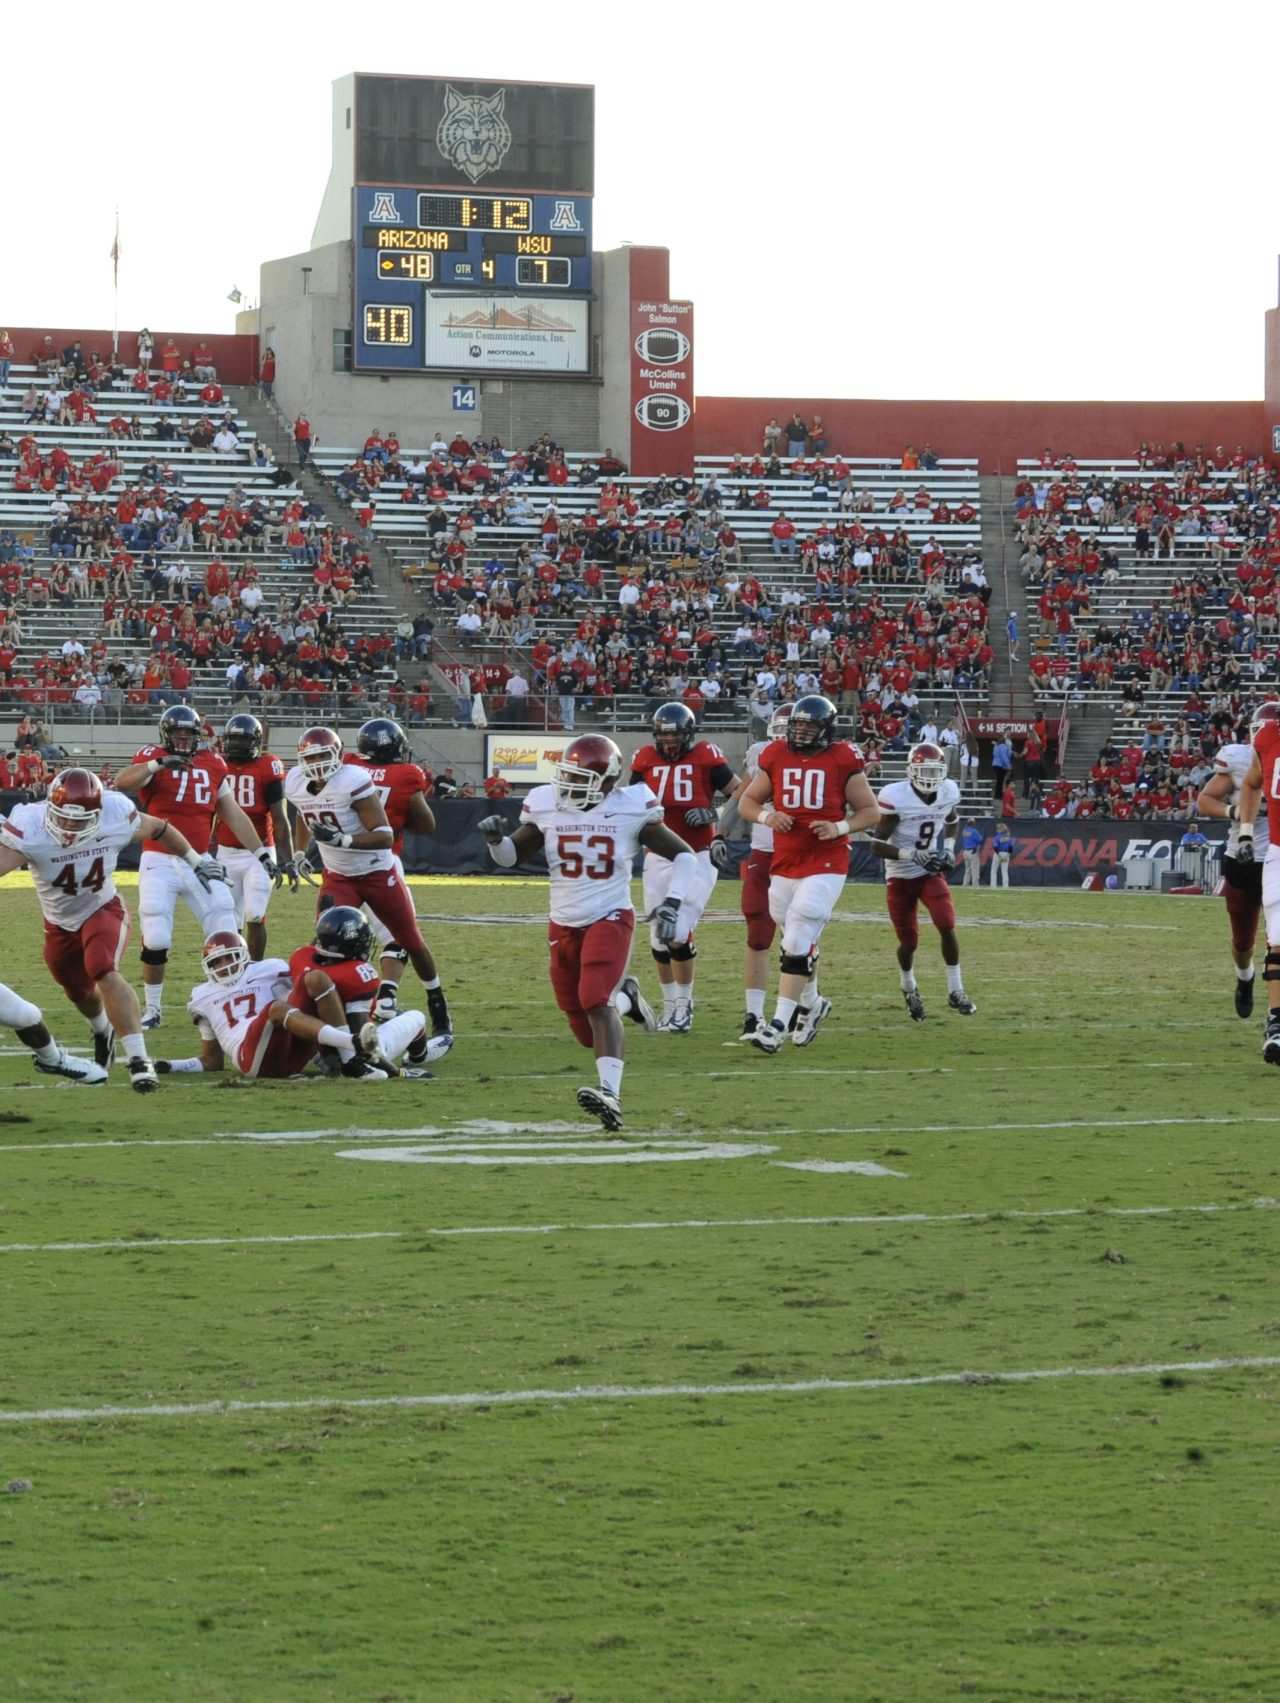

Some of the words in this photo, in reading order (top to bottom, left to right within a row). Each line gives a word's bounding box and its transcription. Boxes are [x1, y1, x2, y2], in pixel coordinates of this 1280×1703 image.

[461, 198, 528, 229] 1:12
[378, 229, 448, 250] ARIZONA
[517, 236, 552, 254] WSU
[401, 254, 431, 278] 48
[481, 260, 494, 279] 4
[534, 260, 548, 283] 7
[638, 303, 657, 312] John
[366, 308, 409, 343] 40
[648, 313, 677, 324] Salmon
[446, 328, 474, 340] Action
[550, 332, 566, 343] Inc.
[640, 368, 686, 379] McCollins
[649, 380, 677, 390] Umeh
[452, 389, 475, 408] 14
[656, 408, 670, 418] 90
[985, 722, 994, 732] 14
[493, 747, 519, 755] 1290
[171, 768, 211, 805] 72
[652, 764, 693, 802] 76
[782, 767, 825, 810] 50
[555, 824, 595, 833] WASHINGTON
[596, 825, 618, 833] STATE
[914, 821, 935, 850] 9
[50, 850, 91, 864] WASHINGTON
[91, 846, 110, 856] STATE
[557, 834, 615, 880] 53
[51, 856, 106, 896] 44
[222, 993, 257, 1029] 17
